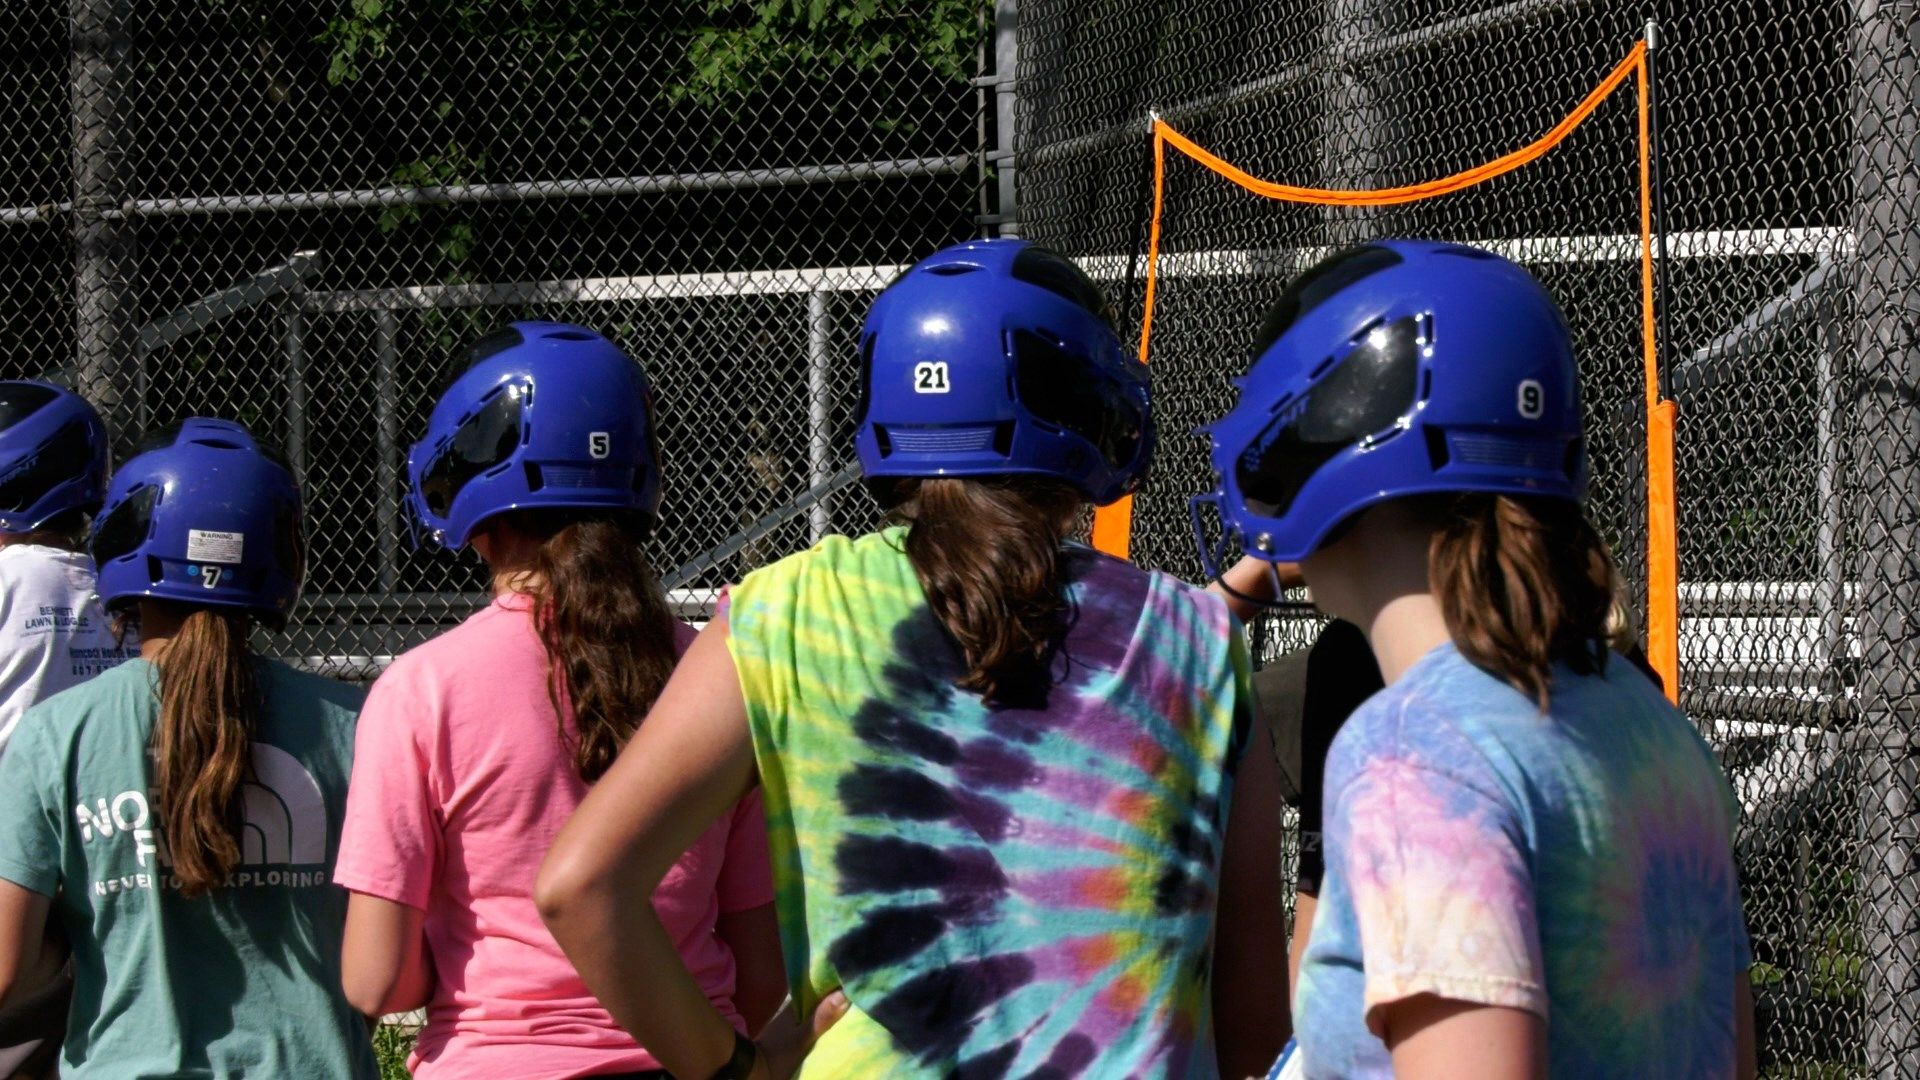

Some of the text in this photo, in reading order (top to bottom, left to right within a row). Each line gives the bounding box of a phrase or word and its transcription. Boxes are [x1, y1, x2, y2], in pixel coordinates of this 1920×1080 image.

[917, 364, 947, 390] 21
[1521, 383, 1541, 416] 9
[591, 434, 607, 457] 5
[200, 531, 233, 540] WARNING
[204, 566, 219, 587] 7
[25, 617, 52, 629] LAWN
[222, 870, 325, 888] XPLORING
